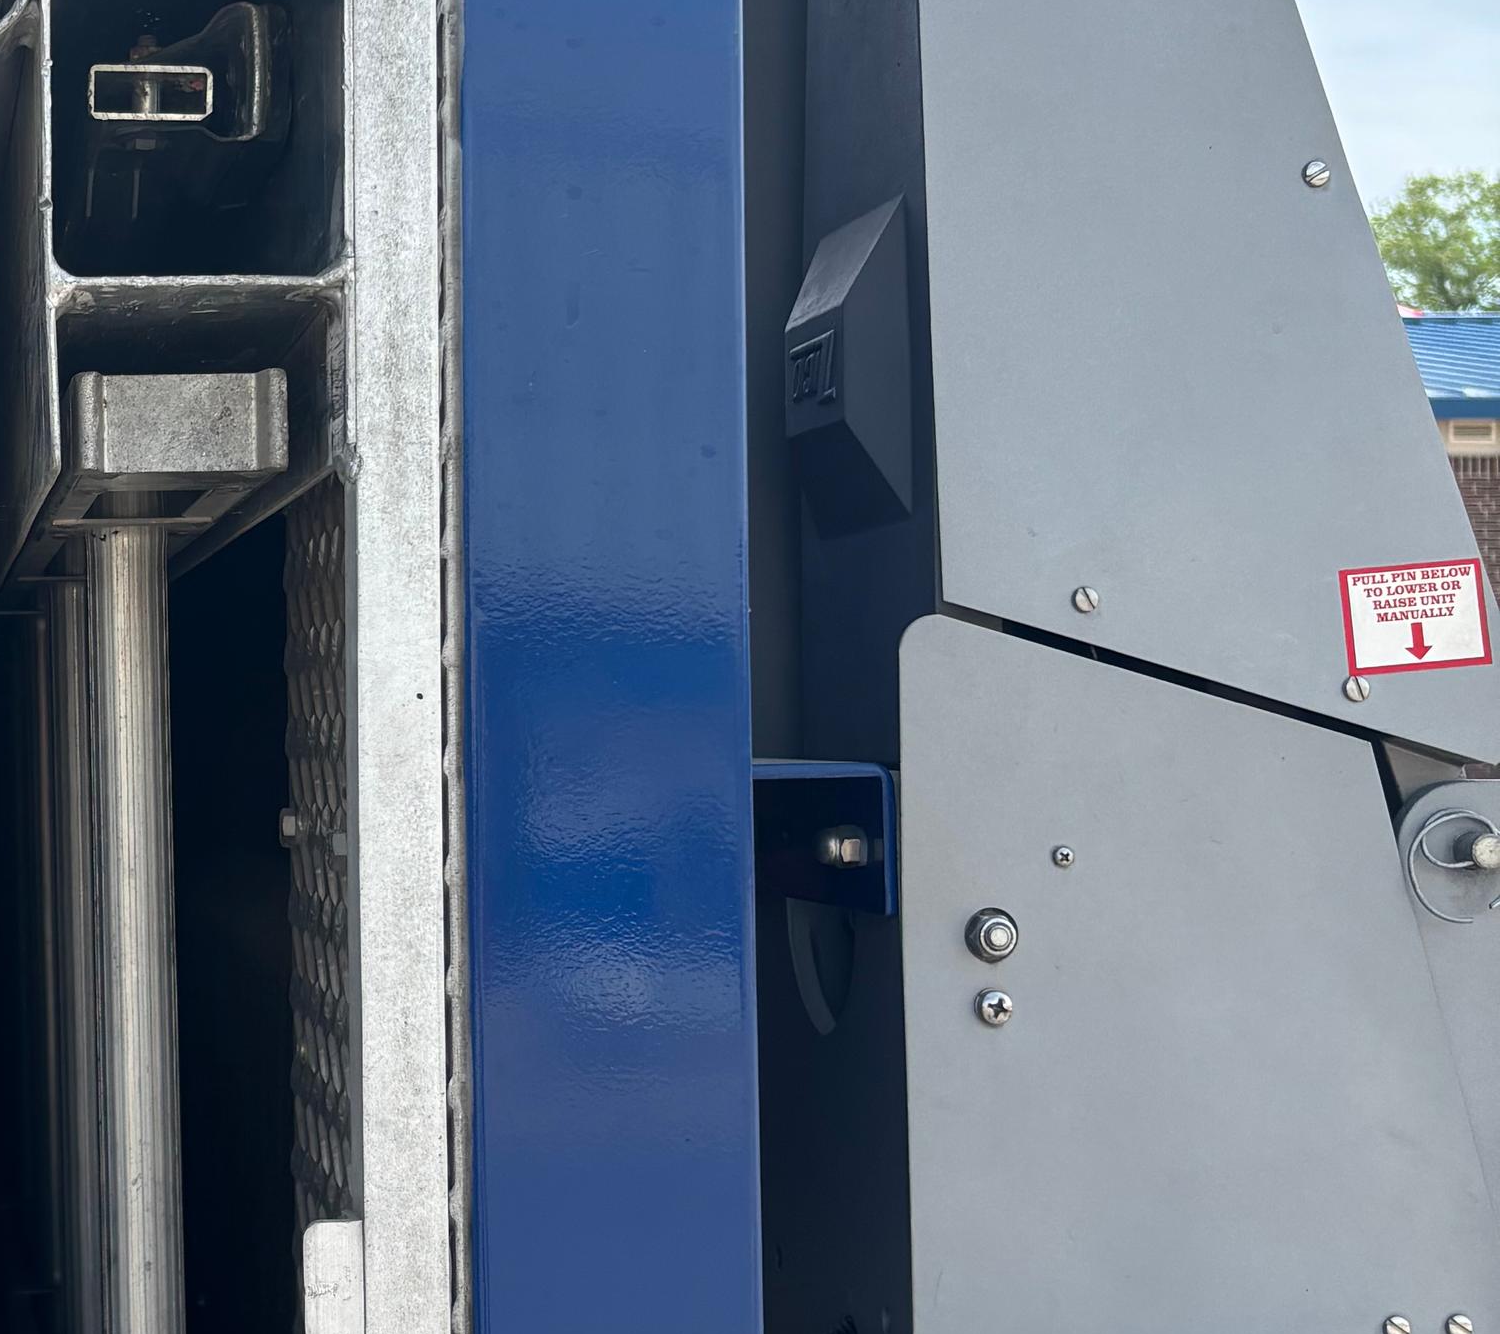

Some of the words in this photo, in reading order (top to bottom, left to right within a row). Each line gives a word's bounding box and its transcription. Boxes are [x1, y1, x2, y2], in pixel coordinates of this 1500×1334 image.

[1352, 573, 1389, 586] PULL
[1391, 571, 1417, 583] PIN
[1421, 566, 1471, 580] BELOW
[1363, 587, 1383, 598] TO
[1386, 583, 1438, 596] LOWER
[1441, 580, 1461, 590] OR
[1373, 597, 1417, 610] RAISE
[1420, 593, 1456, 605] UNIT
[1376, 606, 1455, 623] MANUALLY
